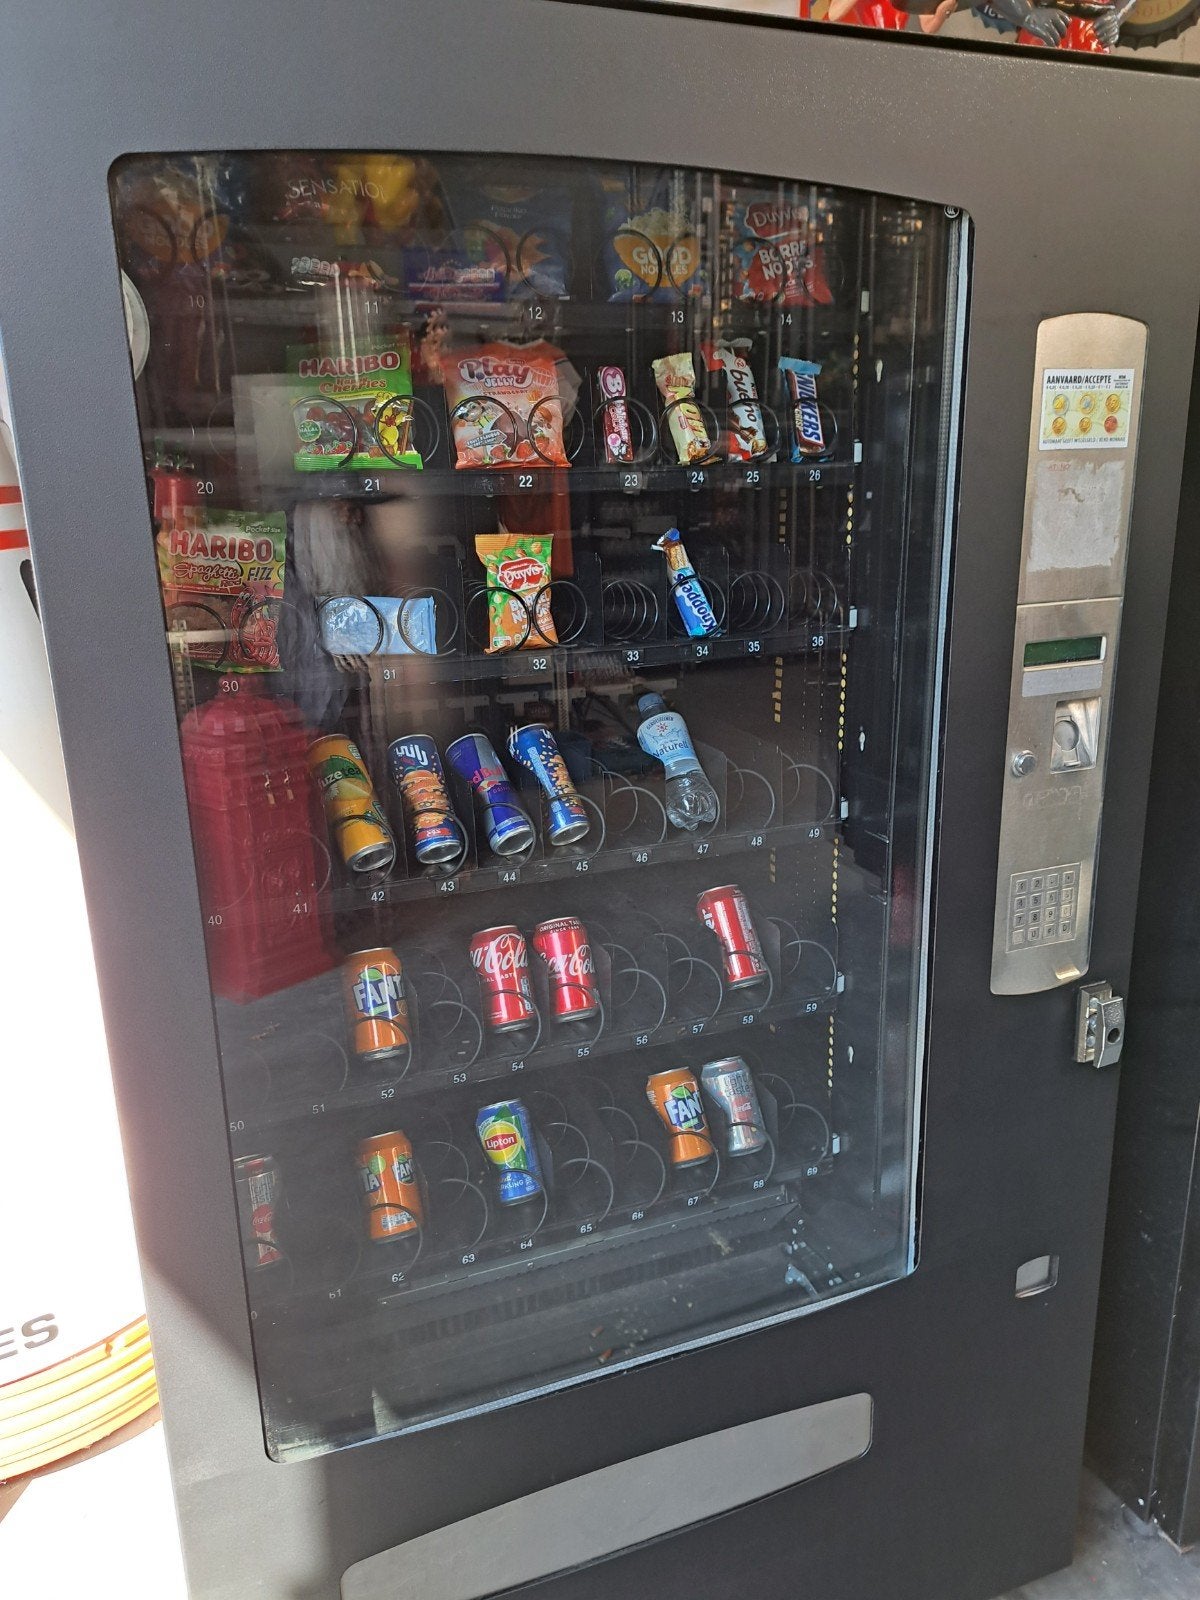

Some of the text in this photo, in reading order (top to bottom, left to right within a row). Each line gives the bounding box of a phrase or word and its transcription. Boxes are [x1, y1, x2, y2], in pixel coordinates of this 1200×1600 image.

[189, 295, 205, 309] 10
[364, 300, 379, 314] 11
[528, 306, 543, 320] 12
[671, 311, 684, 324] 13
[781, 314, 793, 326] 14
[299, 351, 400, 378] HARIBO
[458, 356, 533, 389] Play
[484, 377, 515, 388] JELLY
[1046, 375, 1112, 384] AANVAARD/ACCEPTE
[729, 369, 757, 423] bueno
[519, 475, 533, 487] 22
[624, 474, 638, 487] 23
[691, 471, 704, 483] 24
[746, 471, 759, 483] 25
[809, 470, 821, 481] 26
[196, 481, 214, 494] 20
[364, 478, 380, 491] 21
[168, 529, 274, 563] HARIBO
[173, 562, 239, 581] Spaghetti
[502, 564, 542, 584] Duyvis
[748, 641, 760, 652] 35
[812, 636, 824, 647] 36
[627, 651, 639, 661] 33
[696, 646, 708, 657] 34
[533, 658, 547, 670] 32
[384, 669, 396, 680] 31
[222, 680, 239, 692] 30
[653, 740, 689, 757] Naturell
[809, 828, 820, 838] 49
[751, 836, 763, 846] 48
[697, 844, 709, 854] 47
[636, 852, 648, 863] 46
[576, 861, 589, 872] 45
[503, 872, 516, 882] 44
[440, 881, 455, 892] 43
[371, 890, 385, 901] 42
[293, 903, 308, 913] 41
[208, 914, 222, 925] 40
[353, 974, 405, 1011] FANT
[806, 1003, 817, 1012] 59
[692, 1024, 704, 1033] 57
[636, 1036, 648, 1045] 56
[577, 1048, 590, 1057] 55
[512, 1062, 524, 1072] 54
[453, 1074, 466, 1084] 53
[381, 1089, 395, 1099] 52
[312, 1104, 325, 1114] 51
[665, 1091, 703, 1125] FAN
[230, 1120, 244, 1131] 50
[486, 1136, 515, 1149] Lipton
[391, 1158, 415, 1179] FAN
[807, 1167, 818, 1176] 69
[753, 1181, 764, 1189] 68
[688, 1197, 699, 1206] 67
[632, 1211, 644, 1220] 66
[580, 1224, 593, 1233] 65
[520, 1239, 533, 1250] 64
[462, 1254, 475, 1264] 63
[392, 1273, 405, 1283] 62
